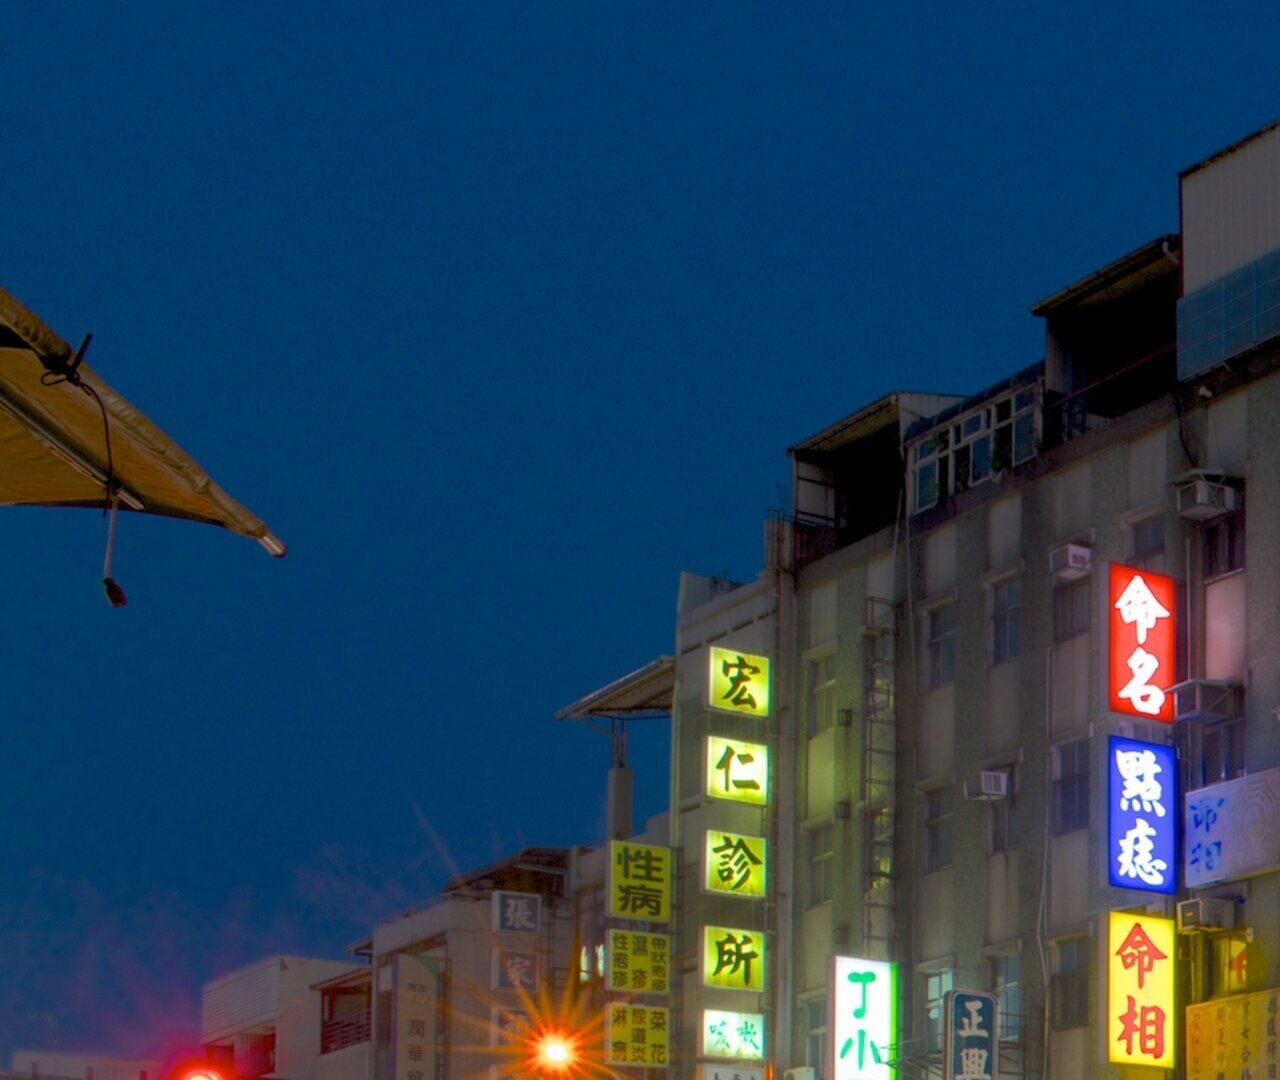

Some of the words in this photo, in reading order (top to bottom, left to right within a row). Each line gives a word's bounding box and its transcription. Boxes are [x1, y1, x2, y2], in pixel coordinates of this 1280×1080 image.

[1114, 574, 1170, 715] 命名
[617, 846, 663, 917] 性病
[713, 655, 762, 987] 宏仁診所
[1115, 749, 1167, 886] 點痣
[709, 1020, 760, 1050] 咳嗽
[1115, 922, 1168, 1060] 命相
